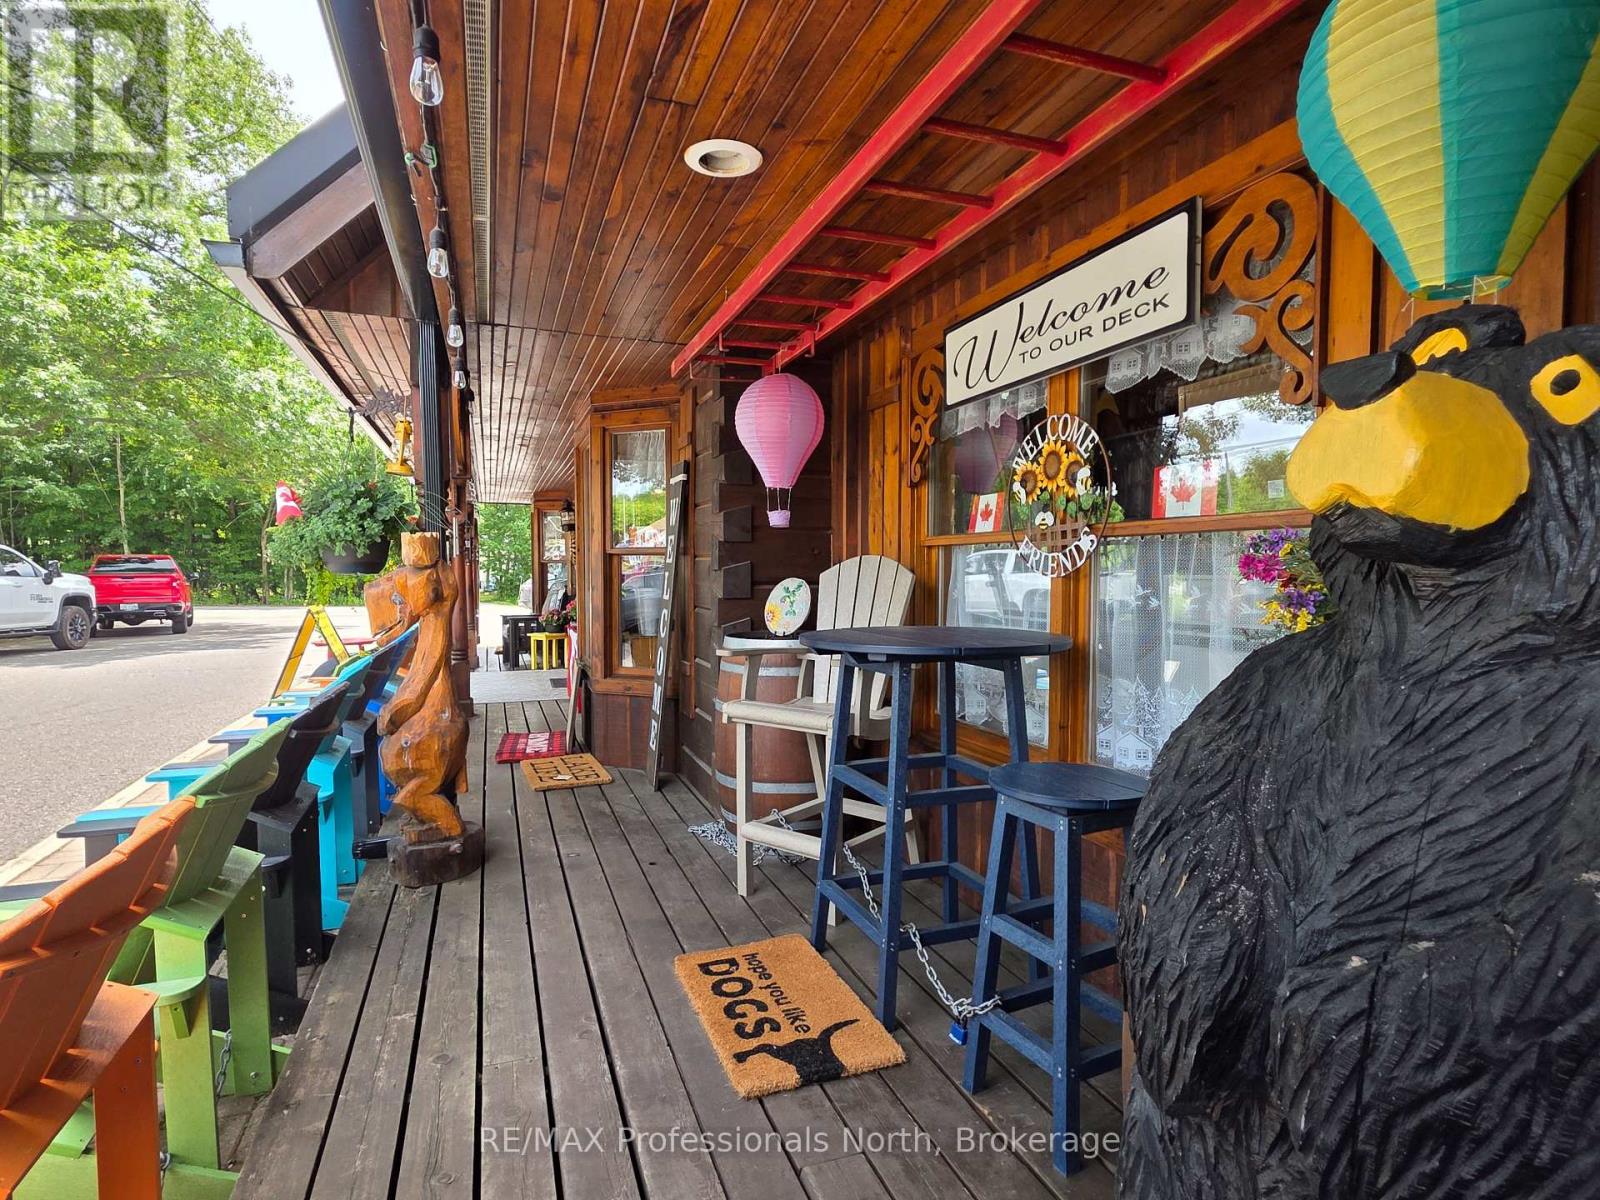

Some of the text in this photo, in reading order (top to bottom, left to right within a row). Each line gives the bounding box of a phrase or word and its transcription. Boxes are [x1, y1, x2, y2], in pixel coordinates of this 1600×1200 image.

[952, 266, 1170, 390] Welcome
[1018, 292, 1170, 364] TO OUR DECK
[1012, 413, 1099, 470] WELCOME
[1017, 526, 1098, 578] FRIENDS
[649, 498, 680, 751] WELCOME
[697, 957, 782, 1040] DOGS
[758, 981, 791, 1006] you
[780, 1006, 811, 1034] like
